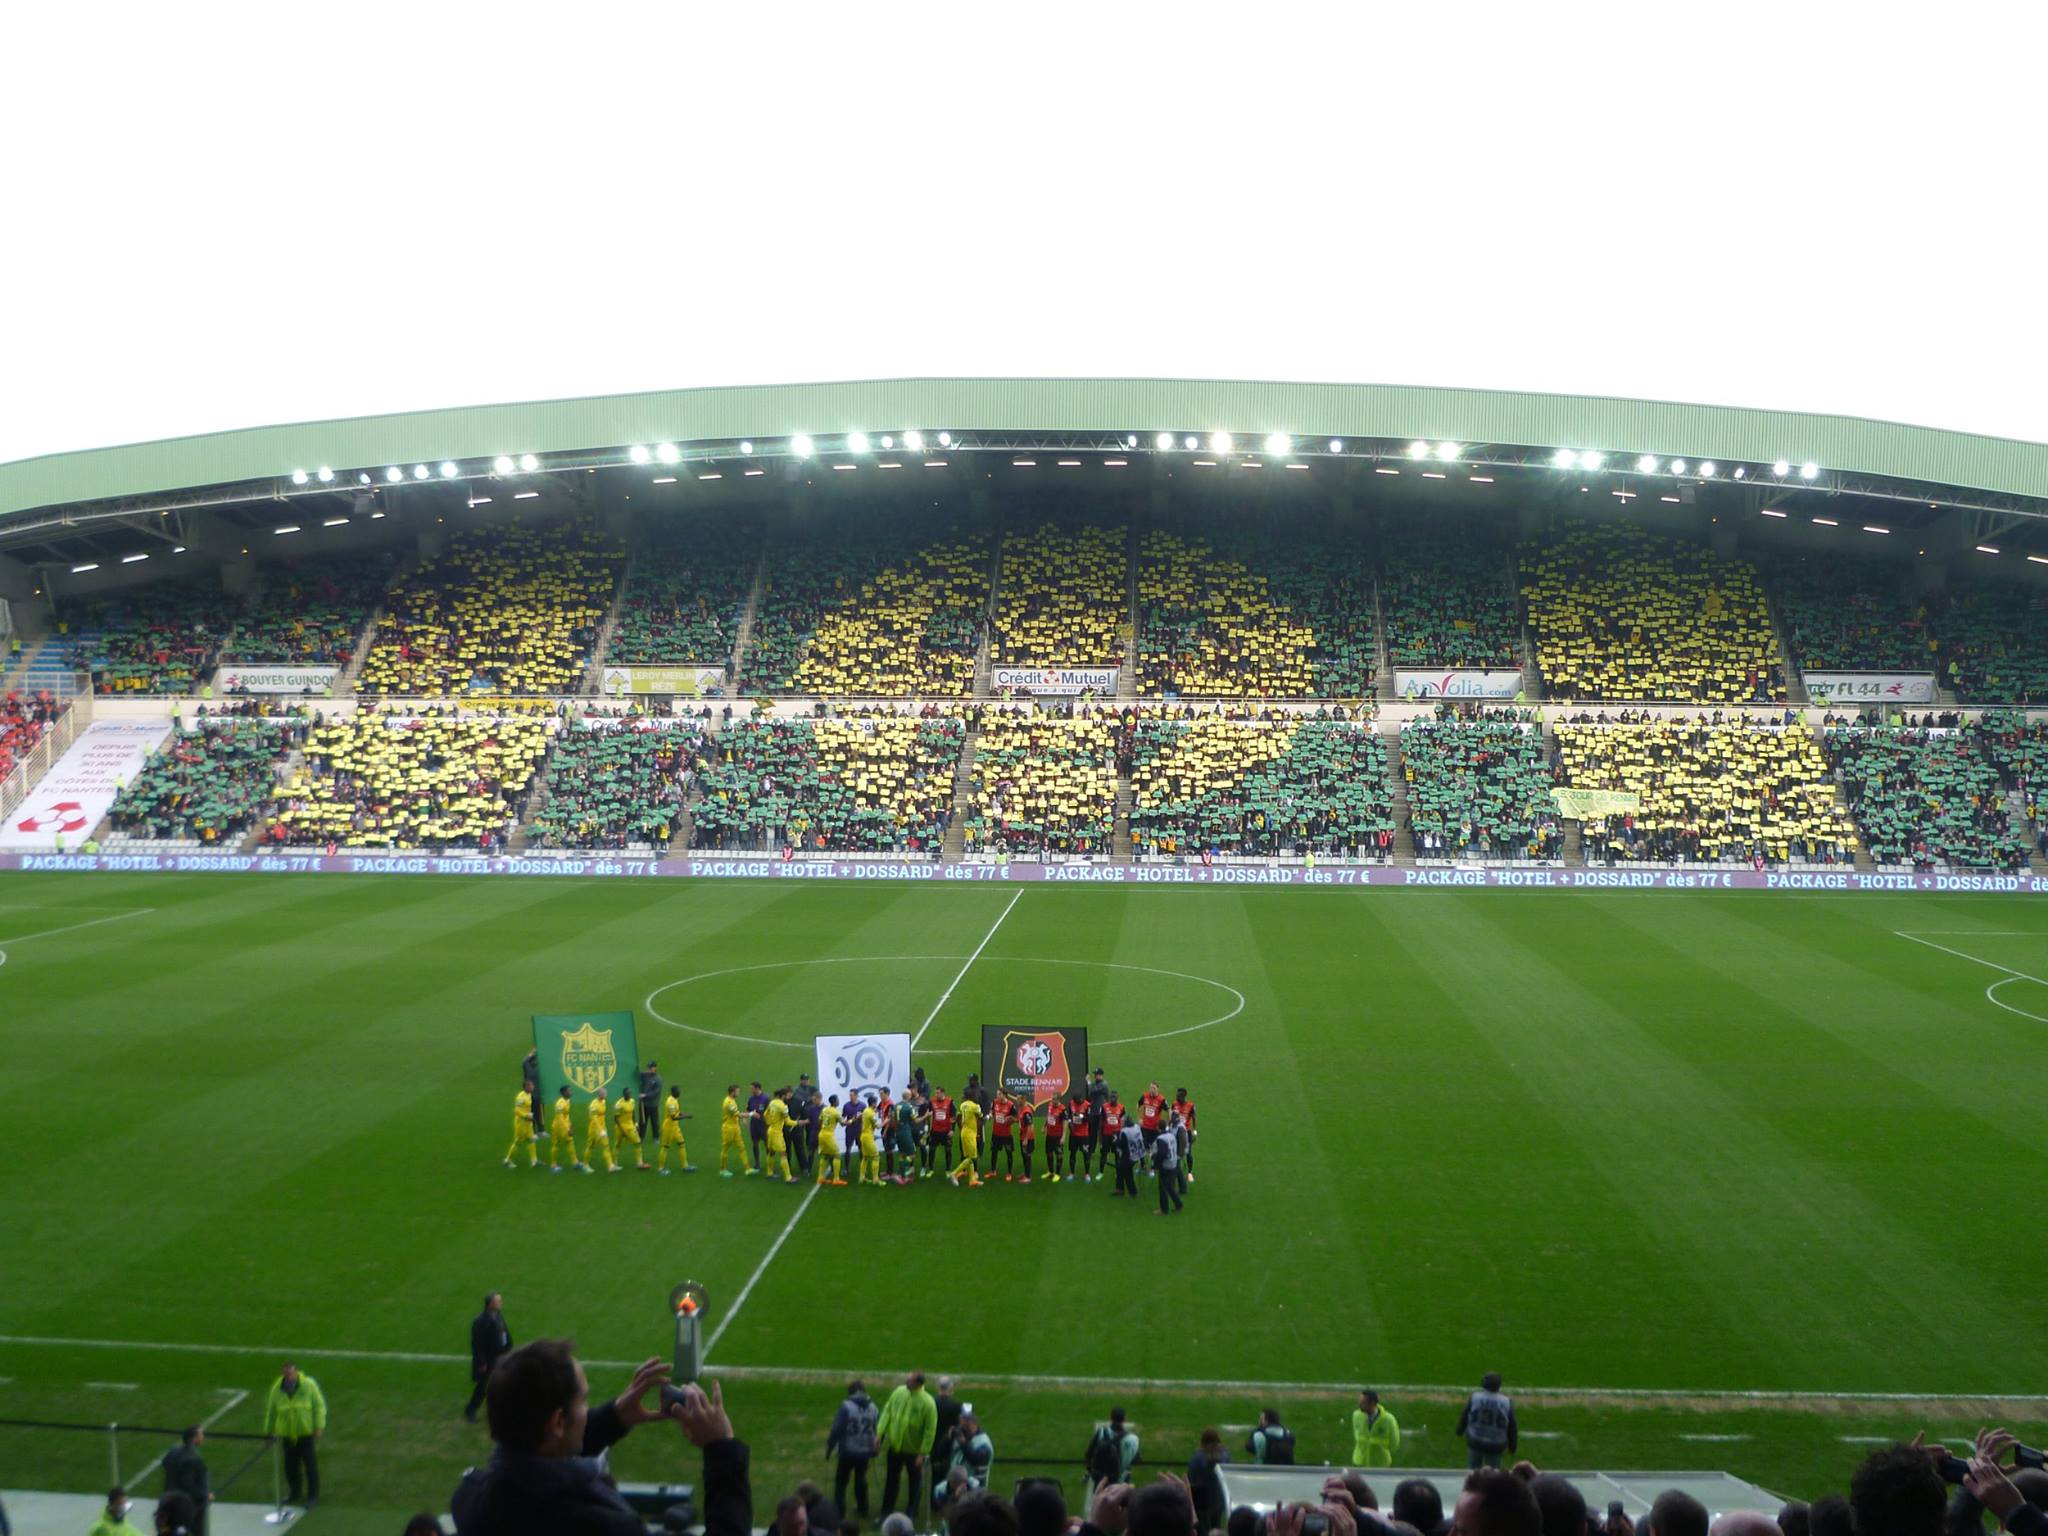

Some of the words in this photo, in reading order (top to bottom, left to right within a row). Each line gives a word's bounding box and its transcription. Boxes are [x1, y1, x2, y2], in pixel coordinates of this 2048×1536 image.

[241, 674, 284, 686] BOUYER
[998, 671, 1042, 684] Crédit
[1061, 672, 1111, 684] Mutuel
[1857, 682, 1881, 696] 44
[22, 855, 97, 870] PACKAGE
[166, 858, 175, 868] +
[262, 856, 288, 871] dès
[291, 856, 309, 871] 77
[312, 856, 321, 871] €
[353, 859, 428, 872] PACKAGE
[496, 862, 505, 871] +
[595, 860, 622, 874] dès
[627, 861, 645, 874] 77
[649, 861, 658, 874] €
[692, 862, 769, 878] PACKAGE
[841, 866, 850, 876] +
[945, 864, 972, 879] dès
[977, 864, 996, 879] 77
[1000, 864, 1008, 879] €
[1044, 866, 1124, 881] PACKAGE
[1198, 870, 1208, 879] +
[1305, 868, 1332, 882] dès
[1337, 868, 1356, 882] 77
[1361, 868, 1370, 883] €
[1406, 870, 1486, 885] PACKAGE
[1560, 874, 1570, 883] +
[1666, 872, 1694, 887] dès
[1699, 872, 1718, 887] 77
[1722, 872, 1731, 887] €
[1767, 874, 1847, 888] PACKAGE
[1922, 878, 1932, 887] +
